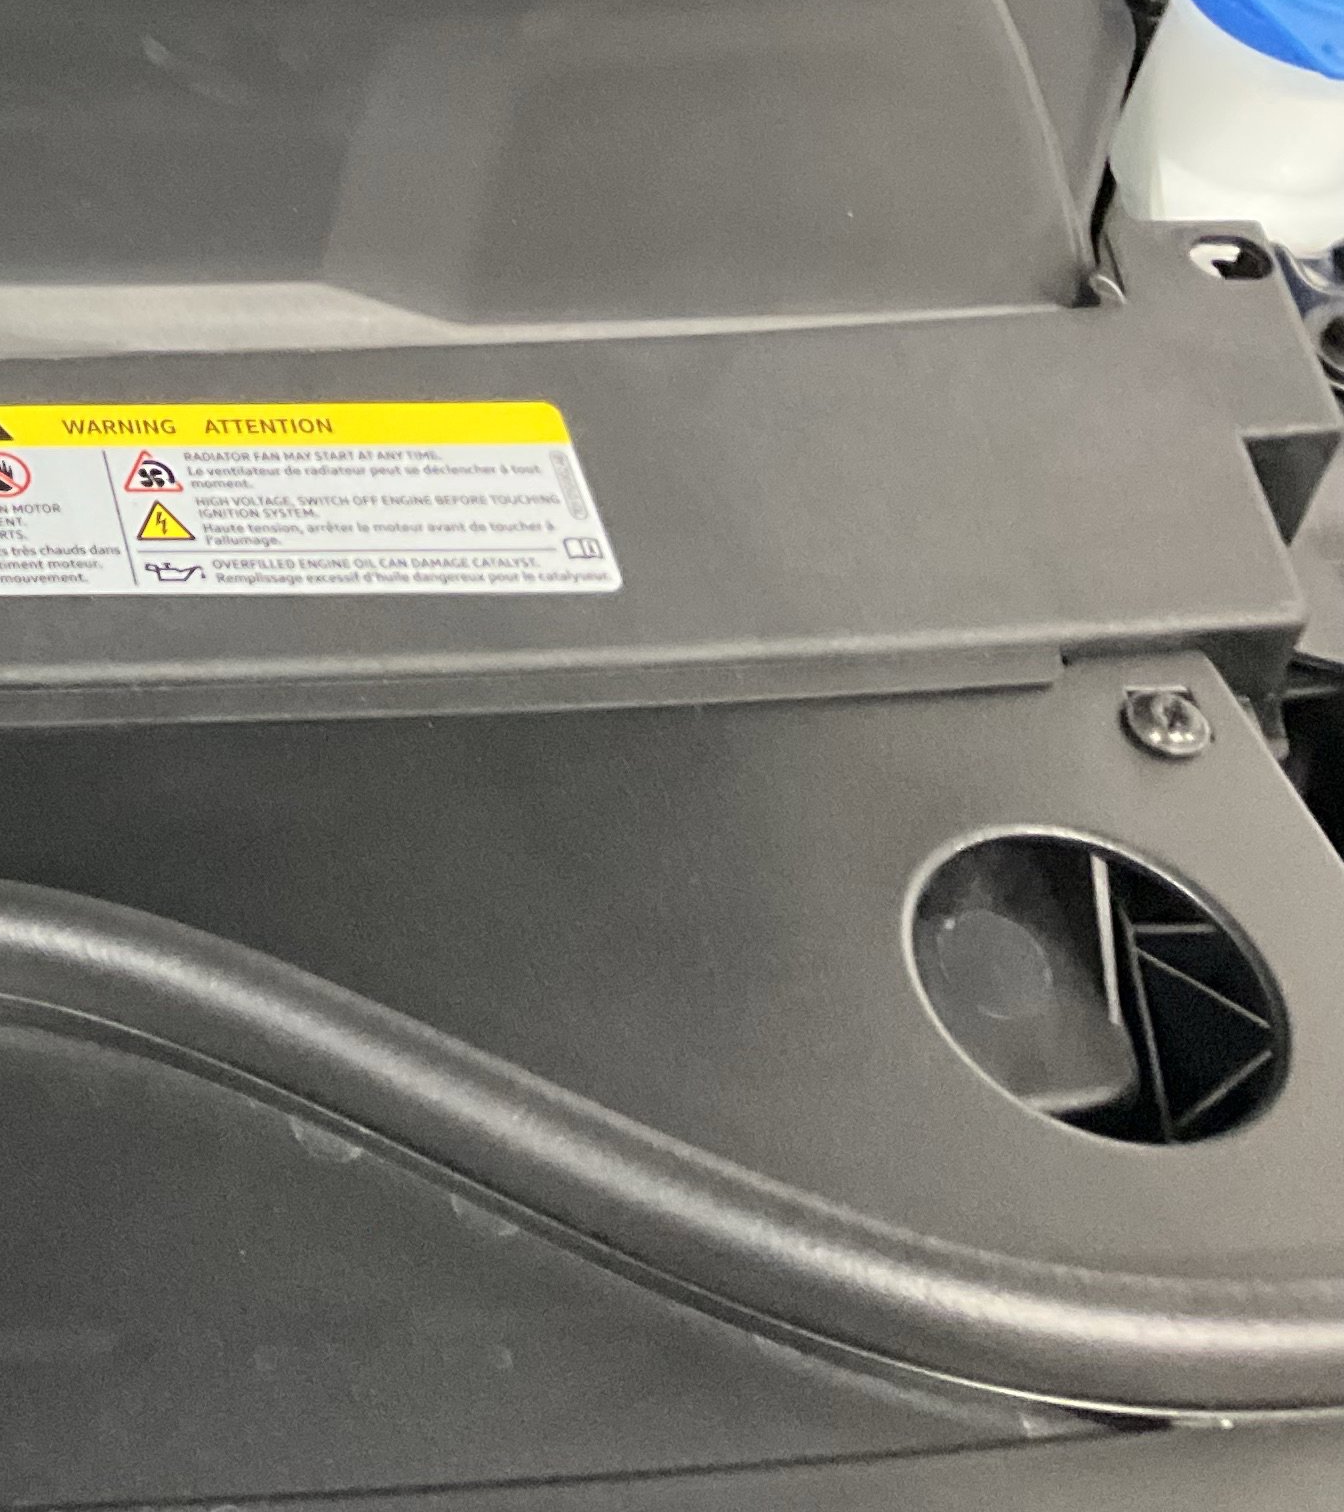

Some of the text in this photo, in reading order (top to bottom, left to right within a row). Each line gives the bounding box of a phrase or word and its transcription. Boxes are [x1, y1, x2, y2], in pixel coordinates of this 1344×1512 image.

[62, 417, 335, 435] WARNING ATTENTION
[183, 451, 250, 462] RADIATOR
[253, 451, 281, 462] FAN
[283, 451, 311, 462] MAY
[314, 450, 354, 461] START
[358, 451, 374, 461] AT
[377, 451, 403, 461] ANY
[187, 465, 205, 476] Le
[207, 465, 280, 476] ventilateur
[283, 465, 302, 476] de
[304, 465, 365, 476] radiateur
[369, 465, 401, 478] peut
[511, 464, 540, 475] tout
[196, 496, 230, 507] HIGH
[297, 495, 350, 506] SWITCH
[352, 495, 379, 506] OFF
[381, 495, 433, 506] ENGINE
[433, 495, 488, 506] BEFORE
[488, 494, 562, 505] TOUCHING
[11, 503, 62, 515] MOTOR
[199, 508, 260, 519] IGNITION
[202, 522, 245, 534] Haute
[372, 522, 423, 533] moteur
[427, 521, 466, 533] avant
[468, 521, 487, 533] de
[489, 521, 542, 533] toucher
[39, 544, 87, 556] chauds
[89, 544, 121, 556] dans
[212, 558, 296, 570] OVERFILLED
[298, 558, 350, 570] ENGINE
[353, 558, 376, 570] OIL
[378, 558, 408, 569] CAN
[411, 557, 469, 569] DAMAGE
[215, 572, 303, 586] Remplissage
